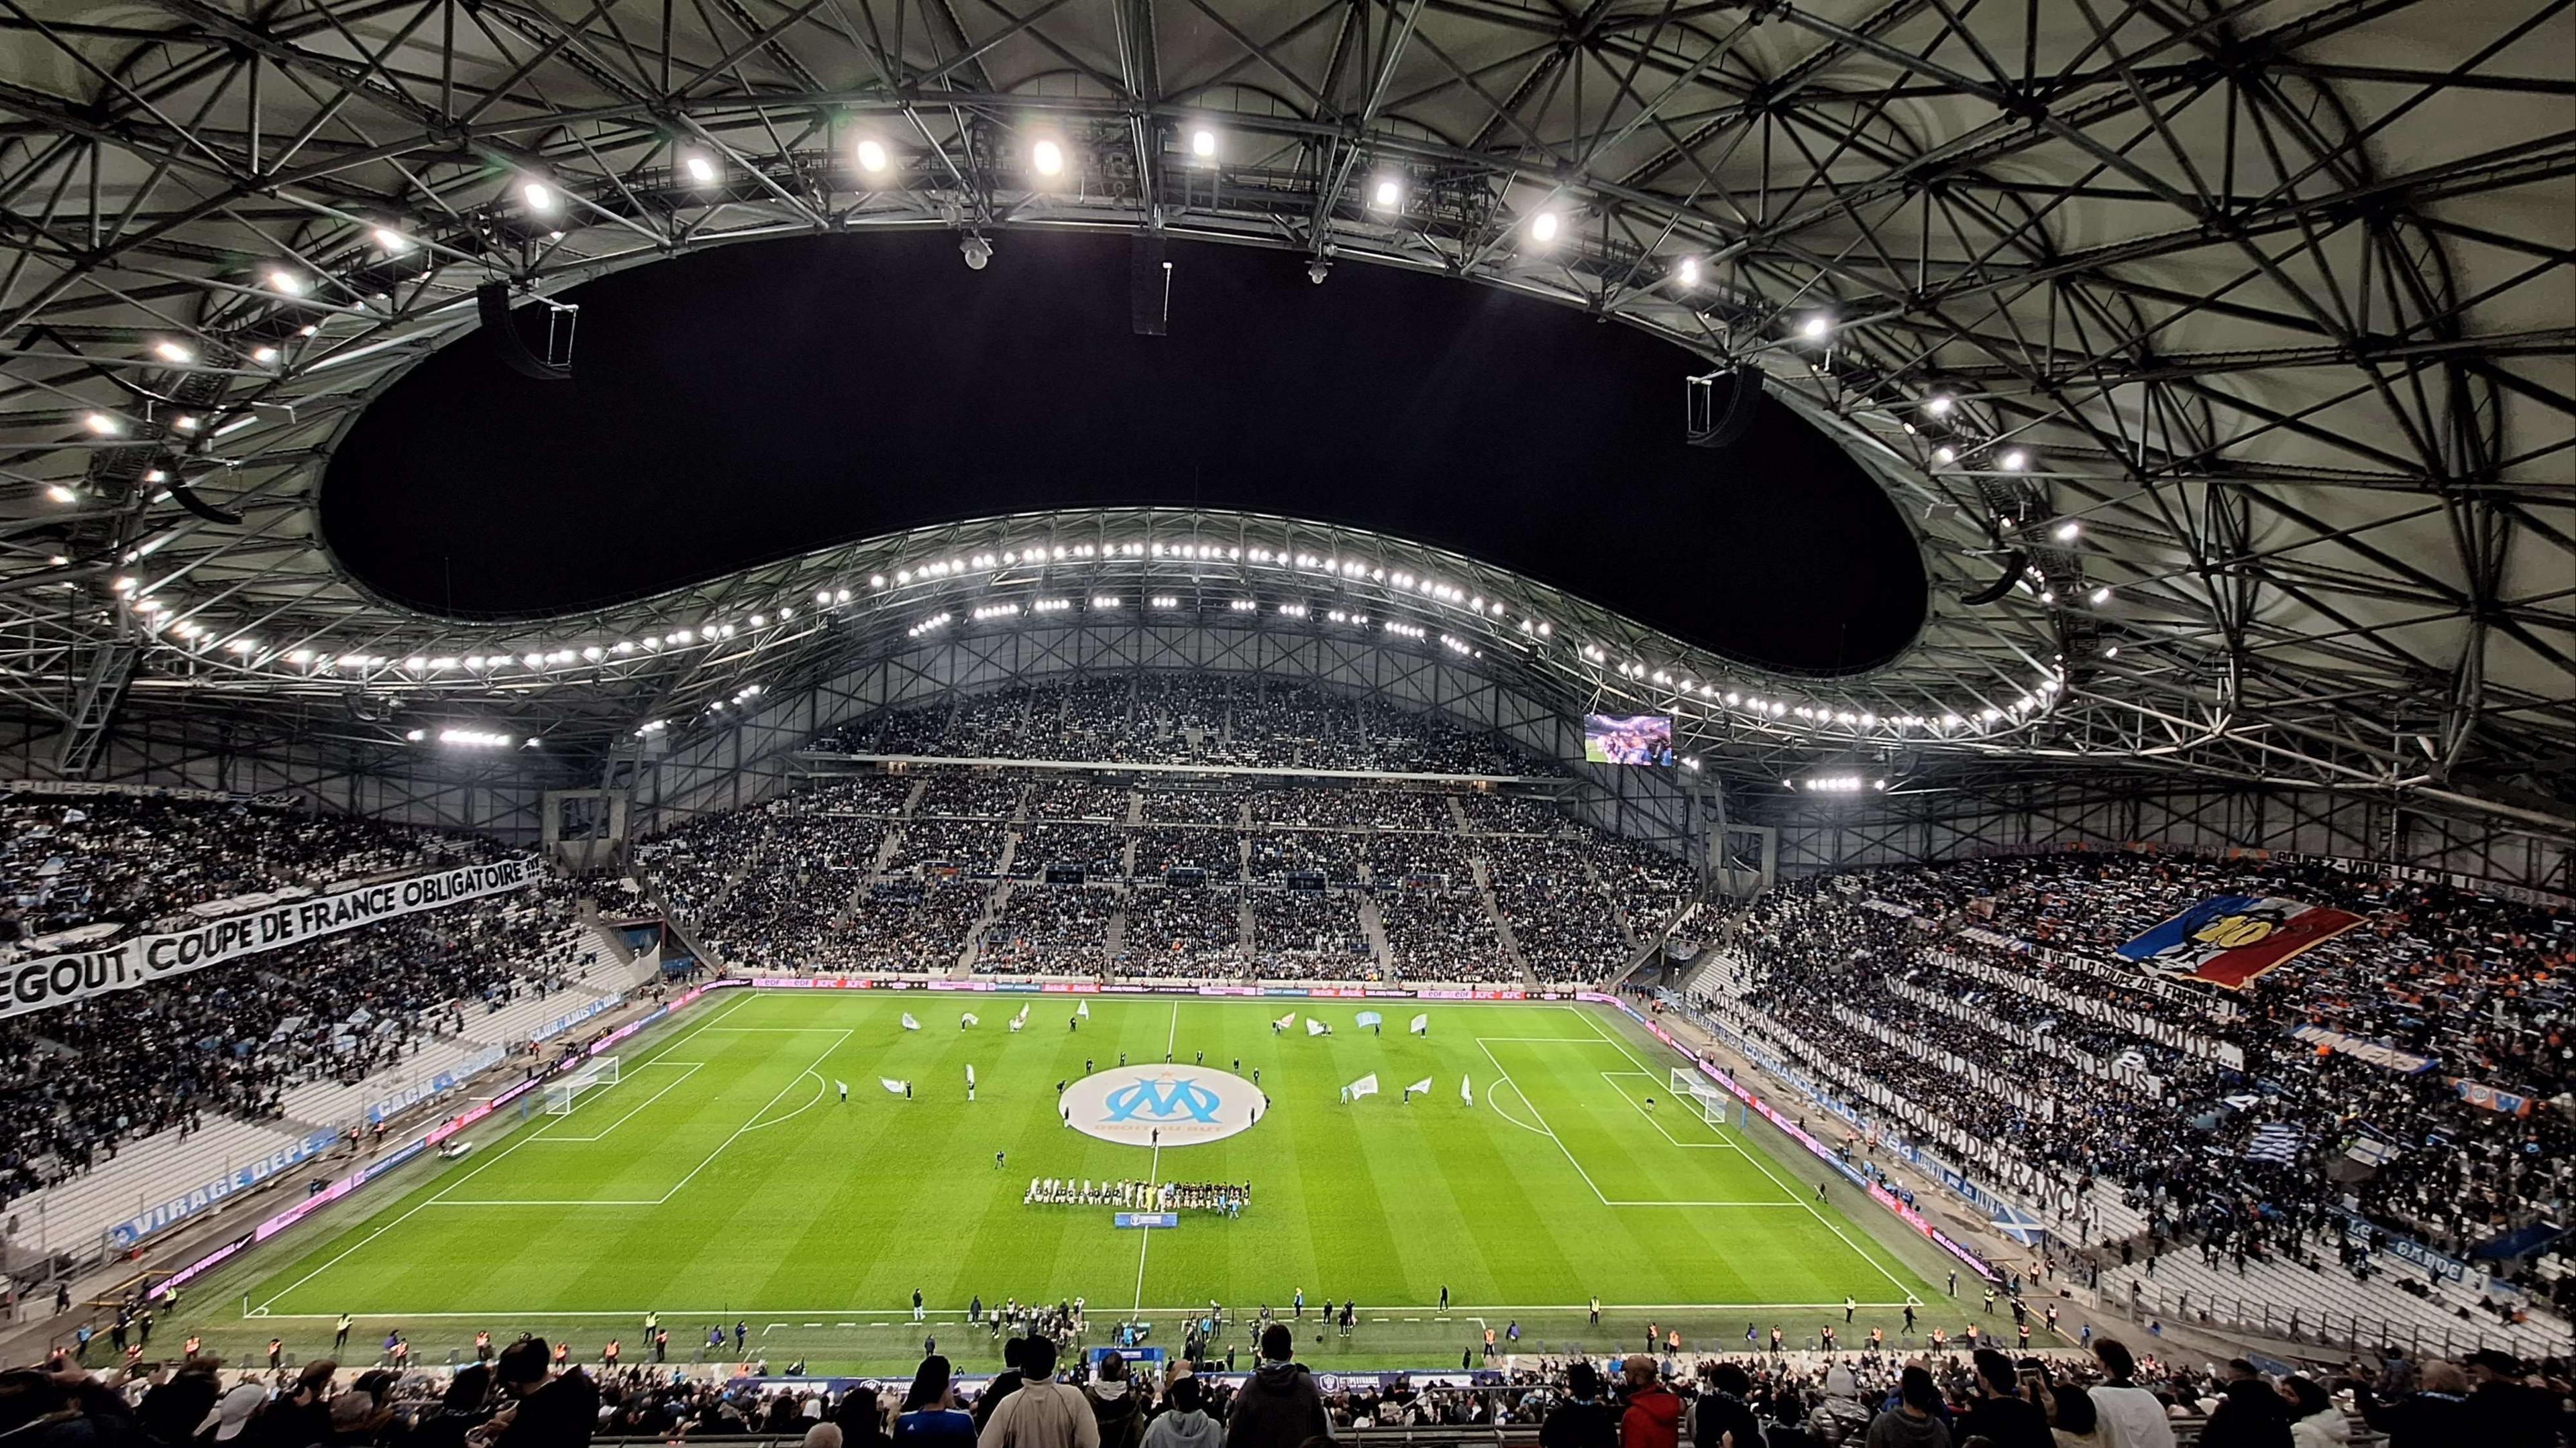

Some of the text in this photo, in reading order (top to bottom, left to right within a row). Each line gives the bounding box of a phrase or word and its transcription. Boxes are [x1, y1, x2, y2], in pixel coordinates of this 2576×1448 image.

[148, 918, 253, 970] COUPE
[261, 909, 292, 944] DE
[300, 887, 396, 933] FRANCE
[403, 862, 523, 906] OBLIGATOIRE
[1978, 963, 2045, 999] PASSION
[2049, 987, 2079, 1013] EST
[2084, 997, 2135, 1030] SANS
[2031, 945, 2045, 959] ON
[2049, 950, 2076, 968] VEUT
[2080, 959, 2096, 974] LA
[2098, 966, 2138, 987] COUPE
[2139, 977, 2159, 993] DE
[2165, 983, 2221, 1013] FRANCE
[1935, 995, 2006, 1038] PATIENCE
[2012, 1023, 2034, 1046] NE
[1794, 1036, 1845, 1082] CHANCE
[1849, 1071, 1876, 1102] EST
[1878, 1084, 1898, 1115] LA
[1902, 1100, 1962, 1149] COUPE
[1964, 1133, 1992, 1168] DE
[1951, 1055, 1974, 1087] LA
[1886, 1131, 1913, 1160] 84
[132, 1170, 244, 1235] VIRAGE
